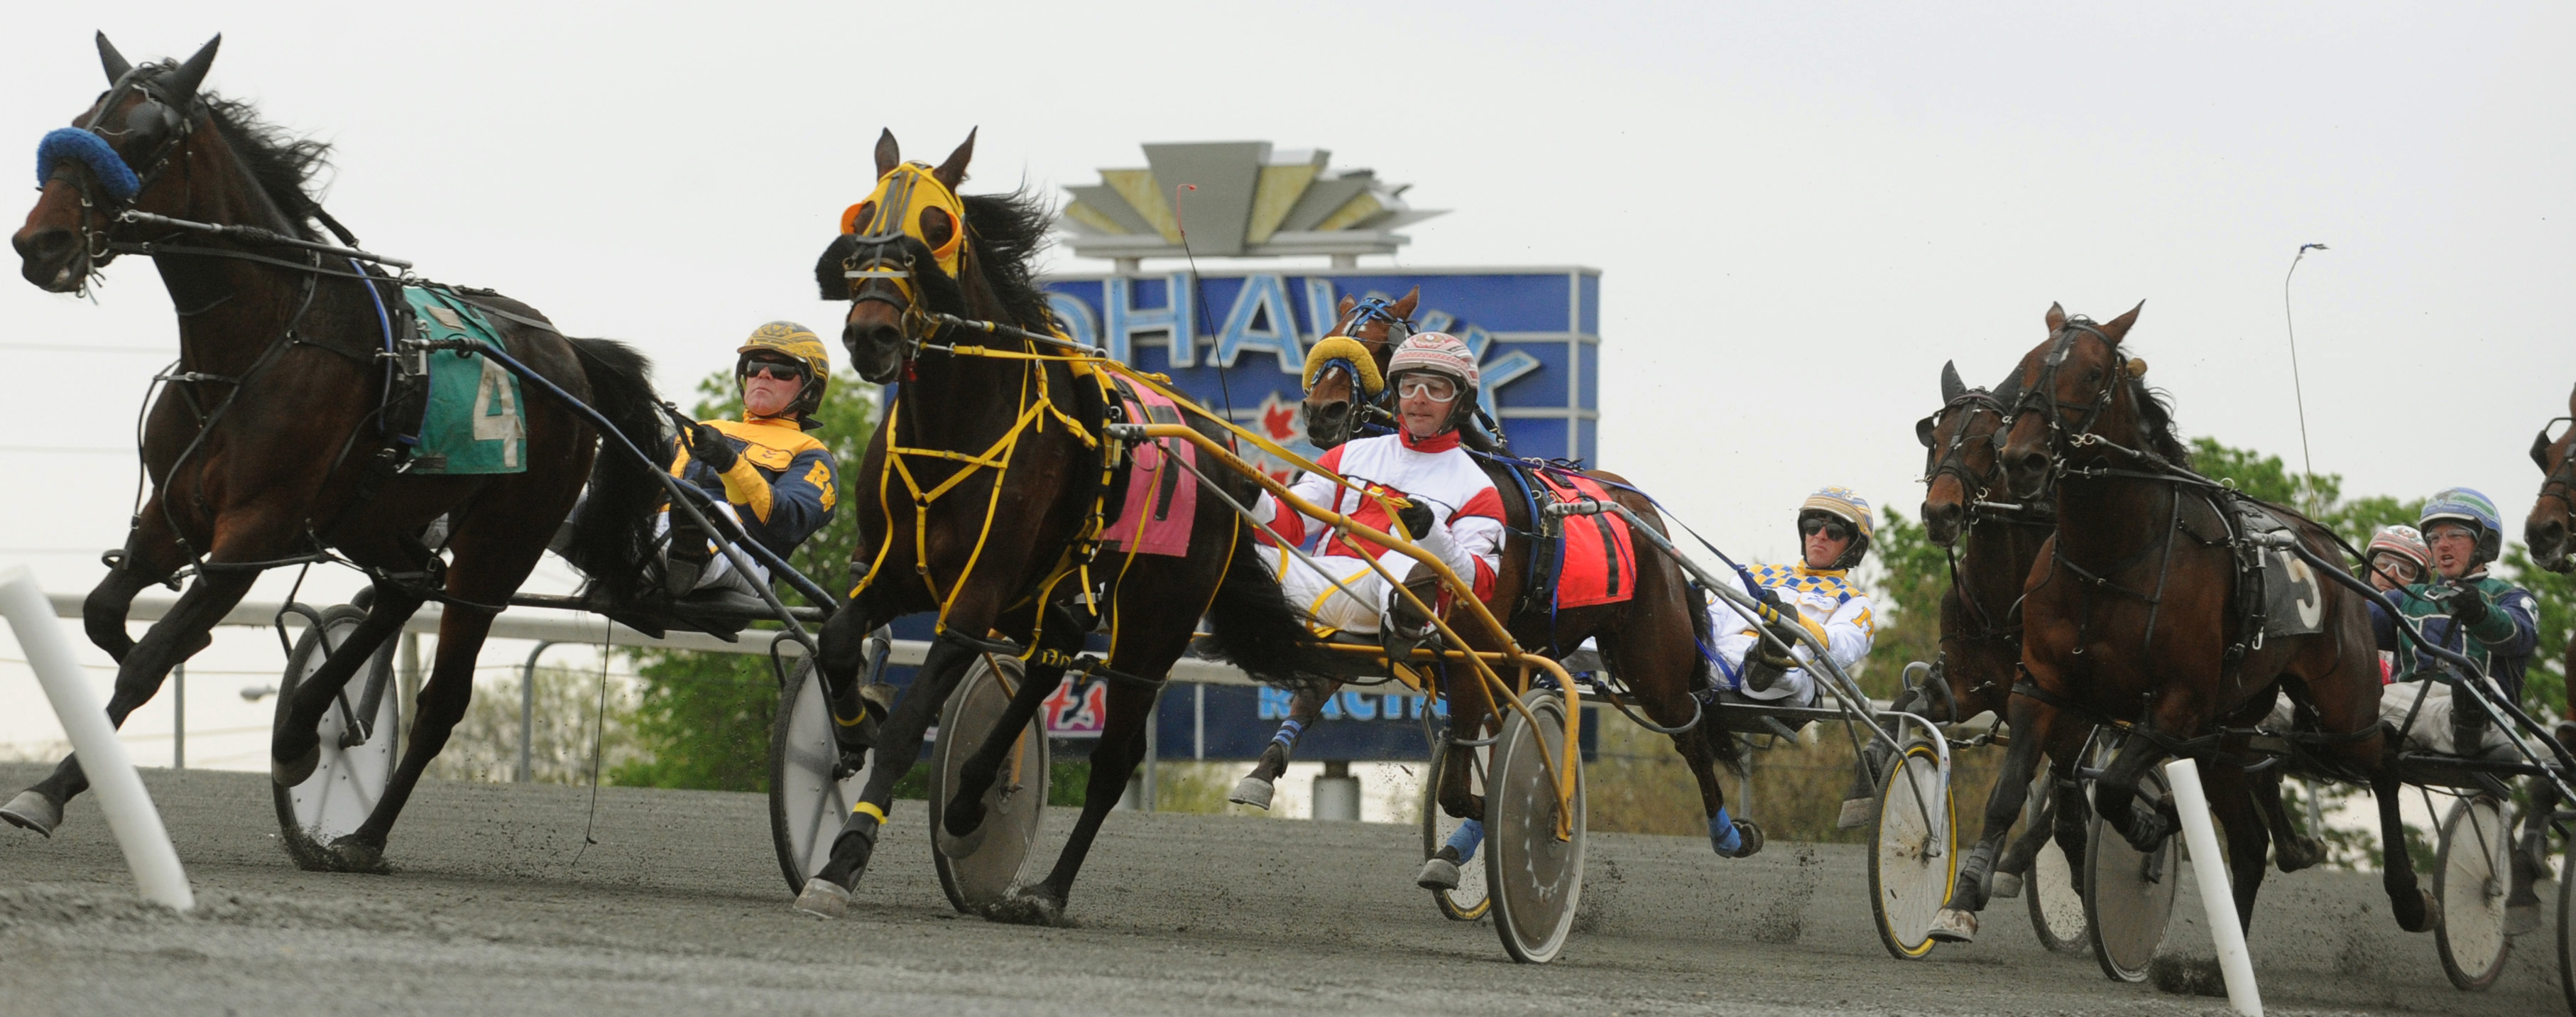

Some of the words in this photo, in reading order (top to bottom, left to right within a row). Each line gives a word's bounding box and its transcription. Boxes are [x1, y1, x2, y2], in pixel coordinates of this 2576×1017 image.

[473, 356, 527, 467] 4
[2278, 550, 2321, 629] 5
[1257, 685, 1448, 720] RCIN
